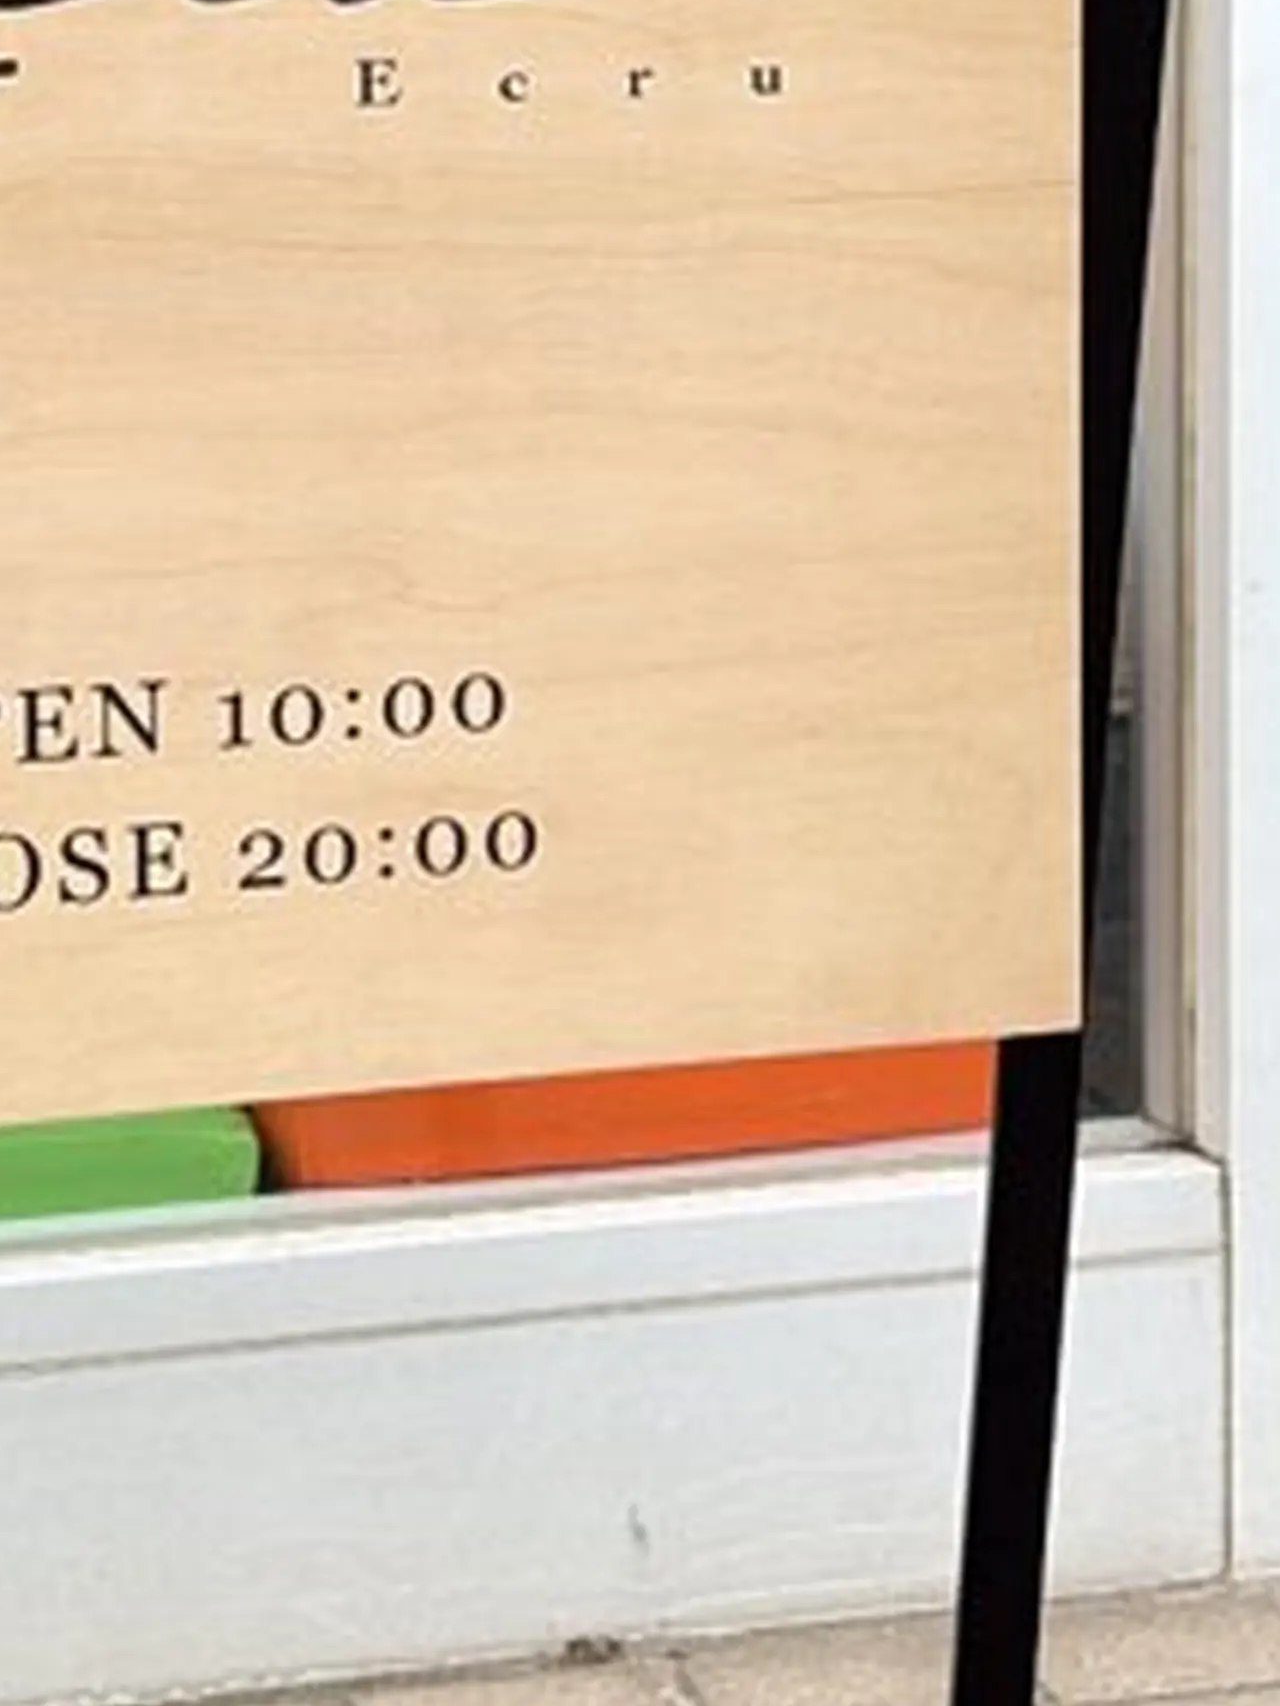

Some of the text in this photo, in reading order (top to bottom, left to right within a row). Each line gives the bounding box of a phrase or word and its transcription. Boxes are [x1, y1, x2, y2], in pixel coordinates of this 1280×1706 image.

[353, 58, 784, 108] Ecru
[218, 672, 507, 750] 10:00
[238, 810, 538, 891] 20:00
